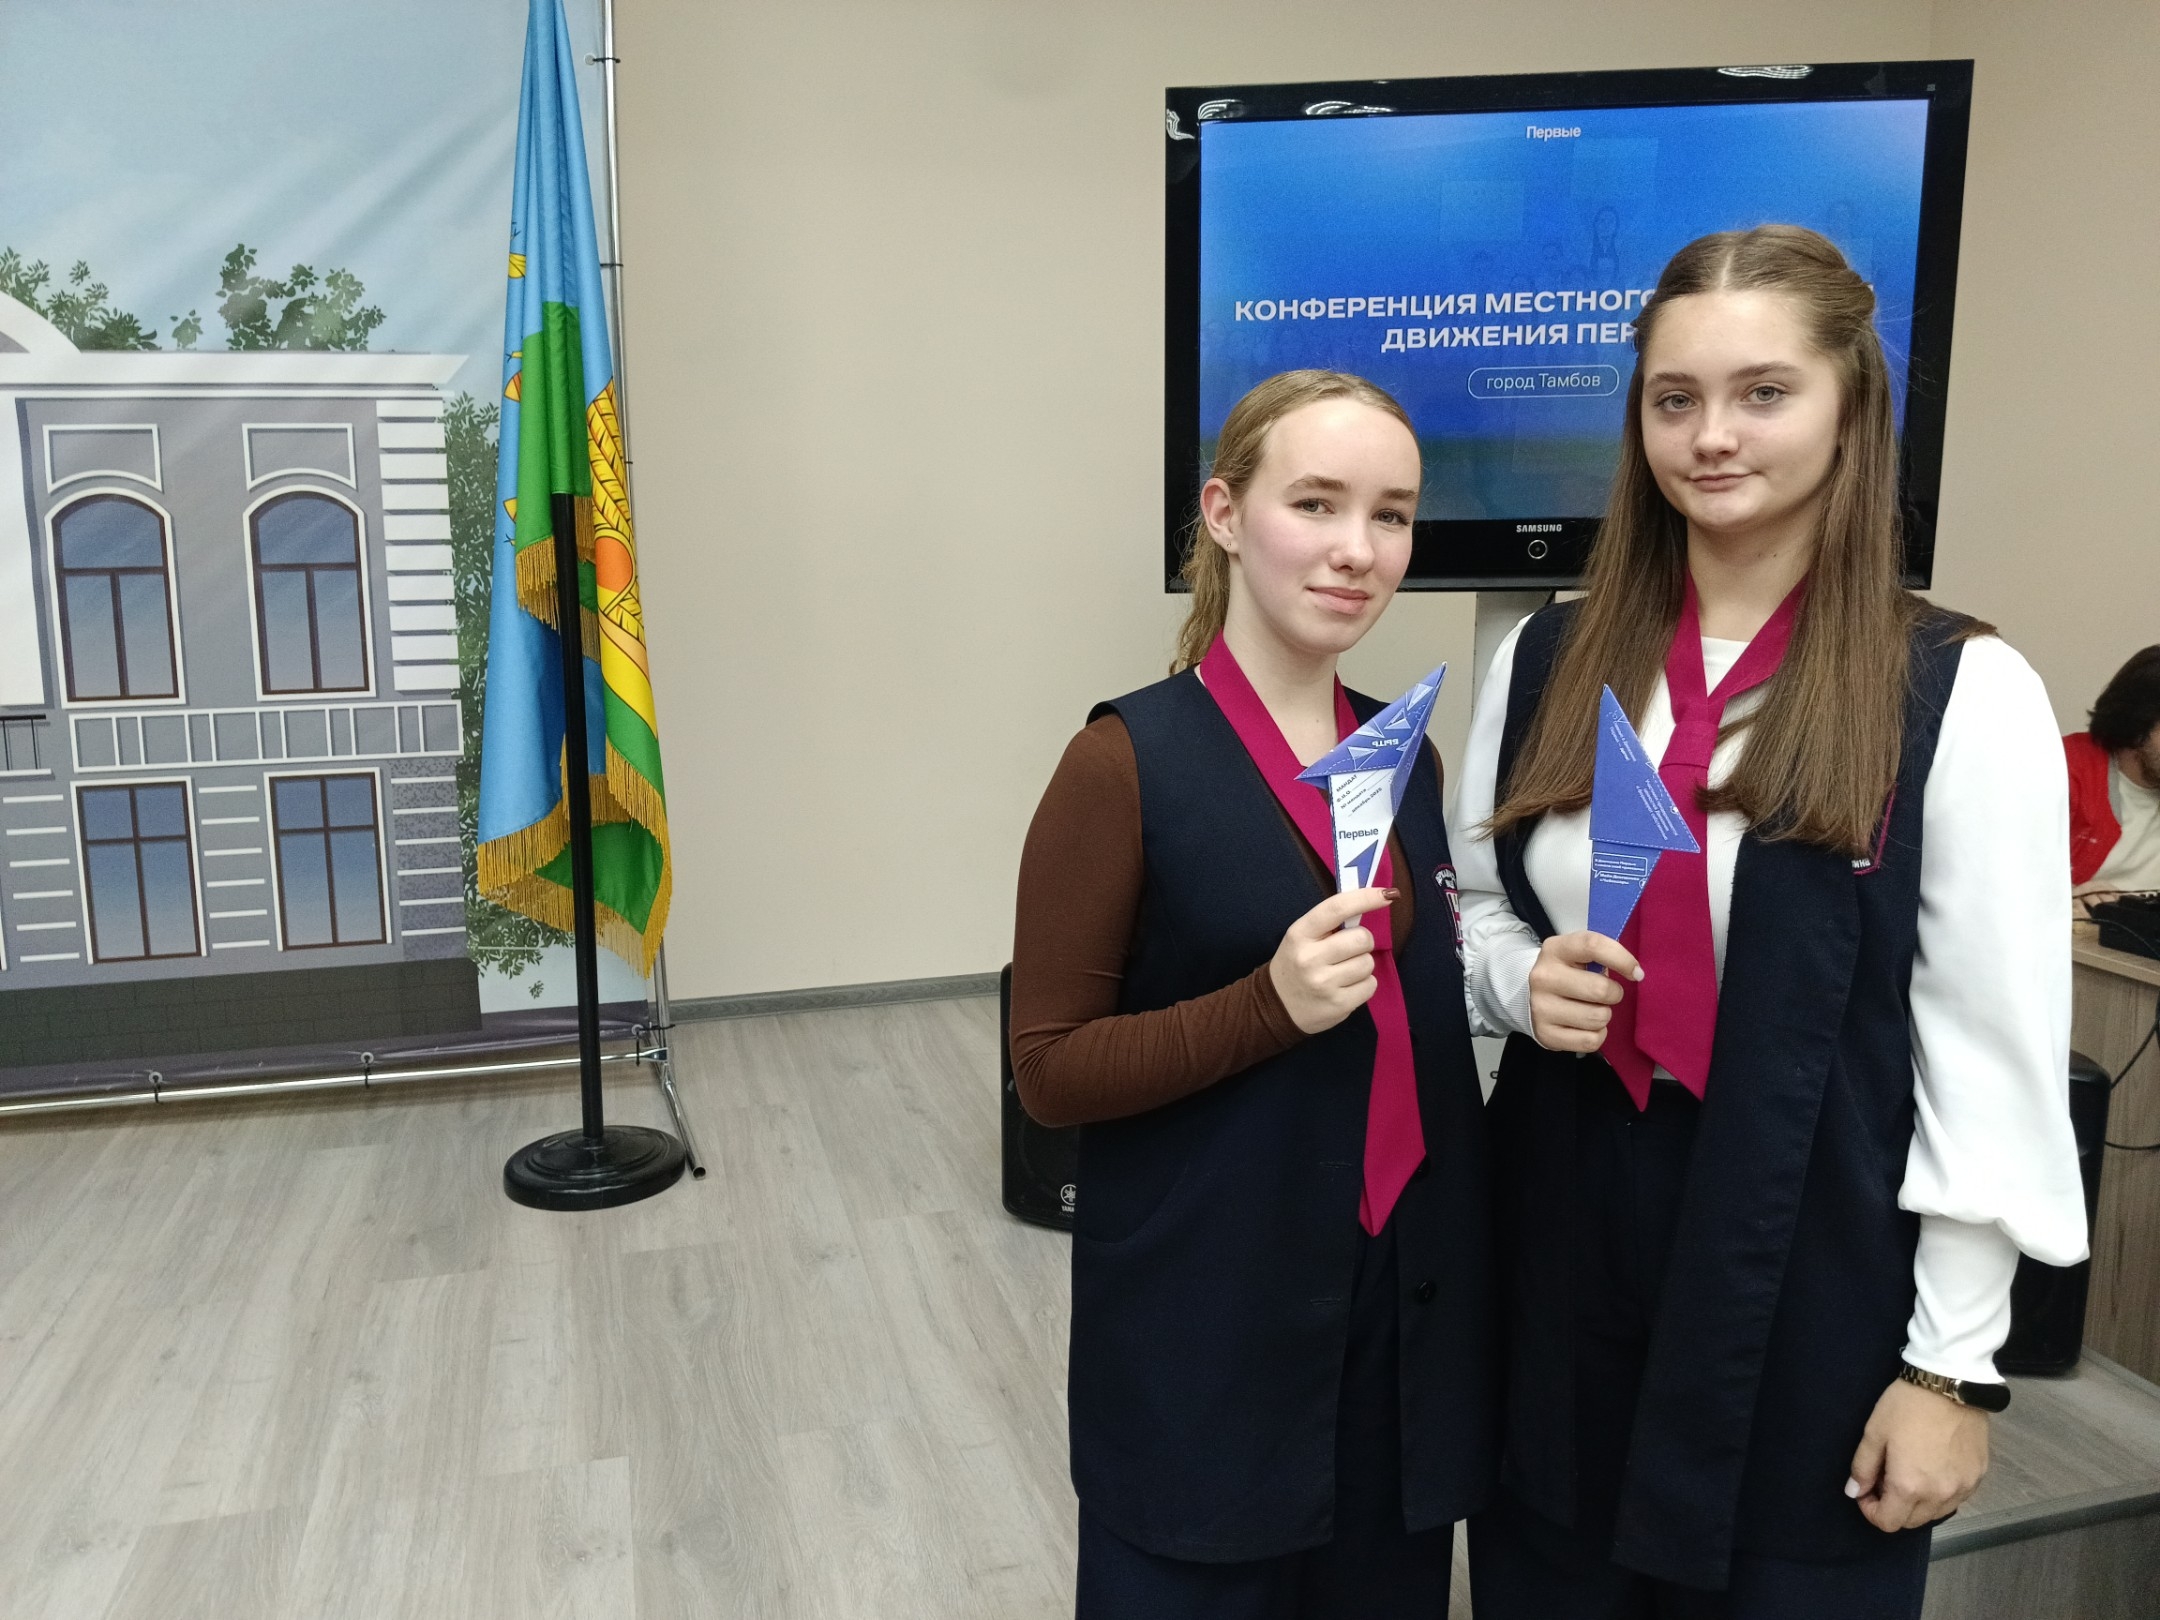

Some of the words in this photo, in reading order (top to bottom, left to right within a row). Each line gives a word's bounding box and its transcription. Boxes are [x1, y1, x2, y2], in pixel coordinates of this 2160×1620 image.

[1526, 126, 1582, 142] Первые
[1235, 294, 1477, 321] КОНФЕРЕНЦИЯ
[1381, 323, 1569, 353] ДВИЖЕНИЯ
[1486, 376, 1535, 391] город
[1539, 372, 1601, 388] Тамбов
[1516, 524, 1562, 533] SAMSUNG
[1371, 738, 1399, 747] БЫТЬ
[1338, 828, 1379, 841] Первые
